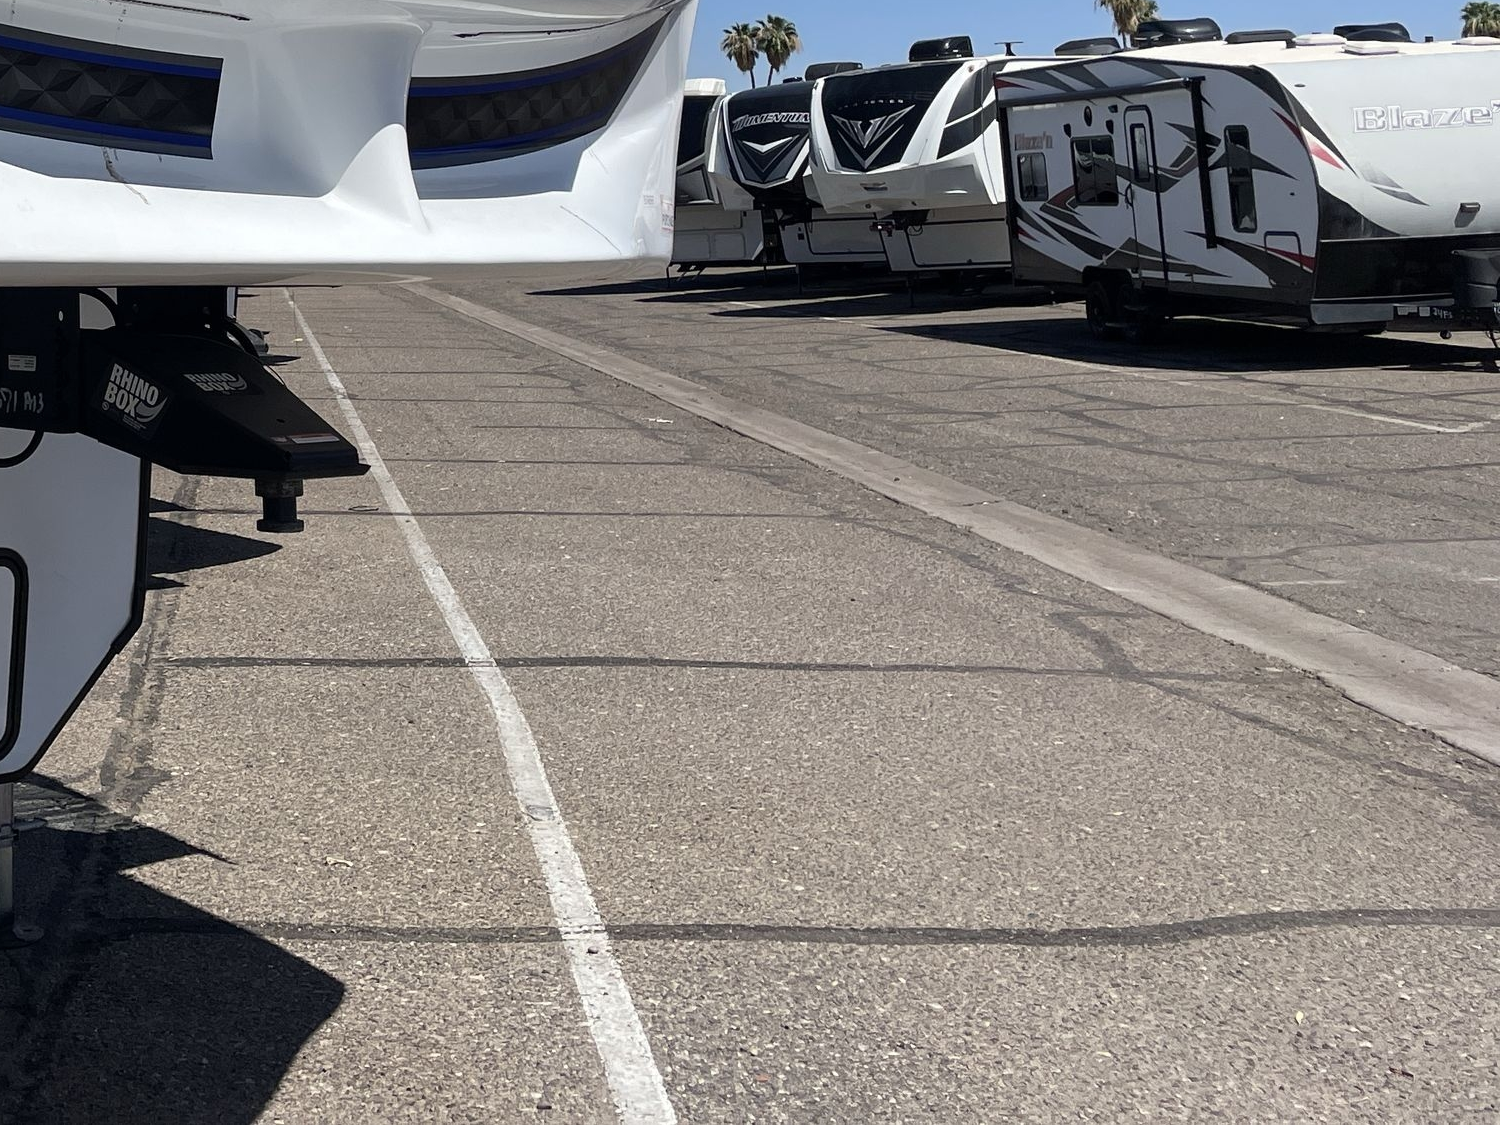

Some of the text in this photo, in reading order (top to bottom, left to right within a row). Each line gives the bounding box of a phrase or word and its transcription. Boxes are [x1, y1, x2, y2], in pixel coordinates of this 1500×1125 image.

[110, 363, 159, 406] RHINO
[183, 373, 237, 383] RHINO
[196, 382, 235, 391] BOX
[104, 382, 139, 417] BOX
